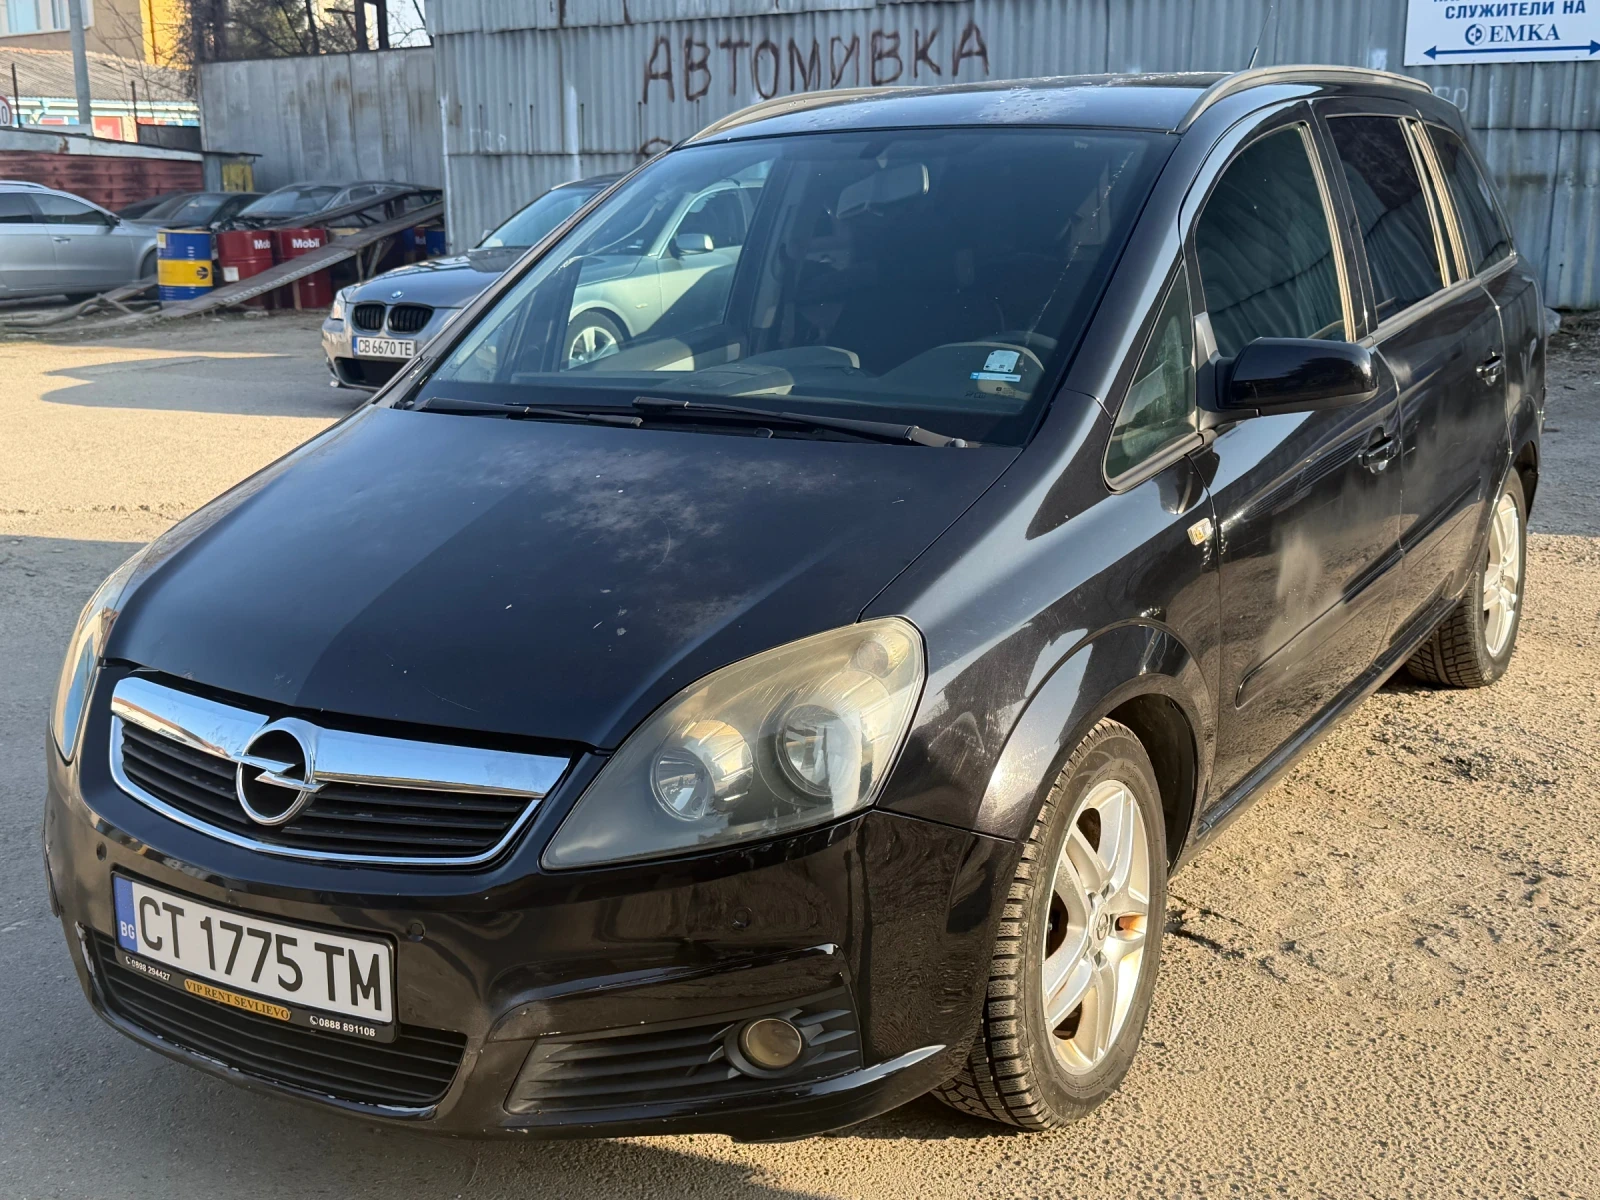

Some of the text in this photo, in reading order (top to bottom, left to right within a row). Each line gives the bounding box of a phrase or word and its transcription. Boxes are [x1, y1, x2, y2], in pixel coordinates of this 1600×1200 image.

[1445, 0, 1587, 19] СЛУЖИТЕЛИ НА
[642, 18, 990, 102] АВТОМИВКА
[291, 237, 320, 249] Mobil
[358, 339, 413, 357] CB 6670 TE
[120, 919, 136, 940] BG
[139, 895, 383, 1012] CT 1775 TM
[147, 965, 171, 982] 294427
[185, 980, 289, 1020] VIP RENT SEVLIEVO
[318, 1017, 376, 1037] 0888 891108
